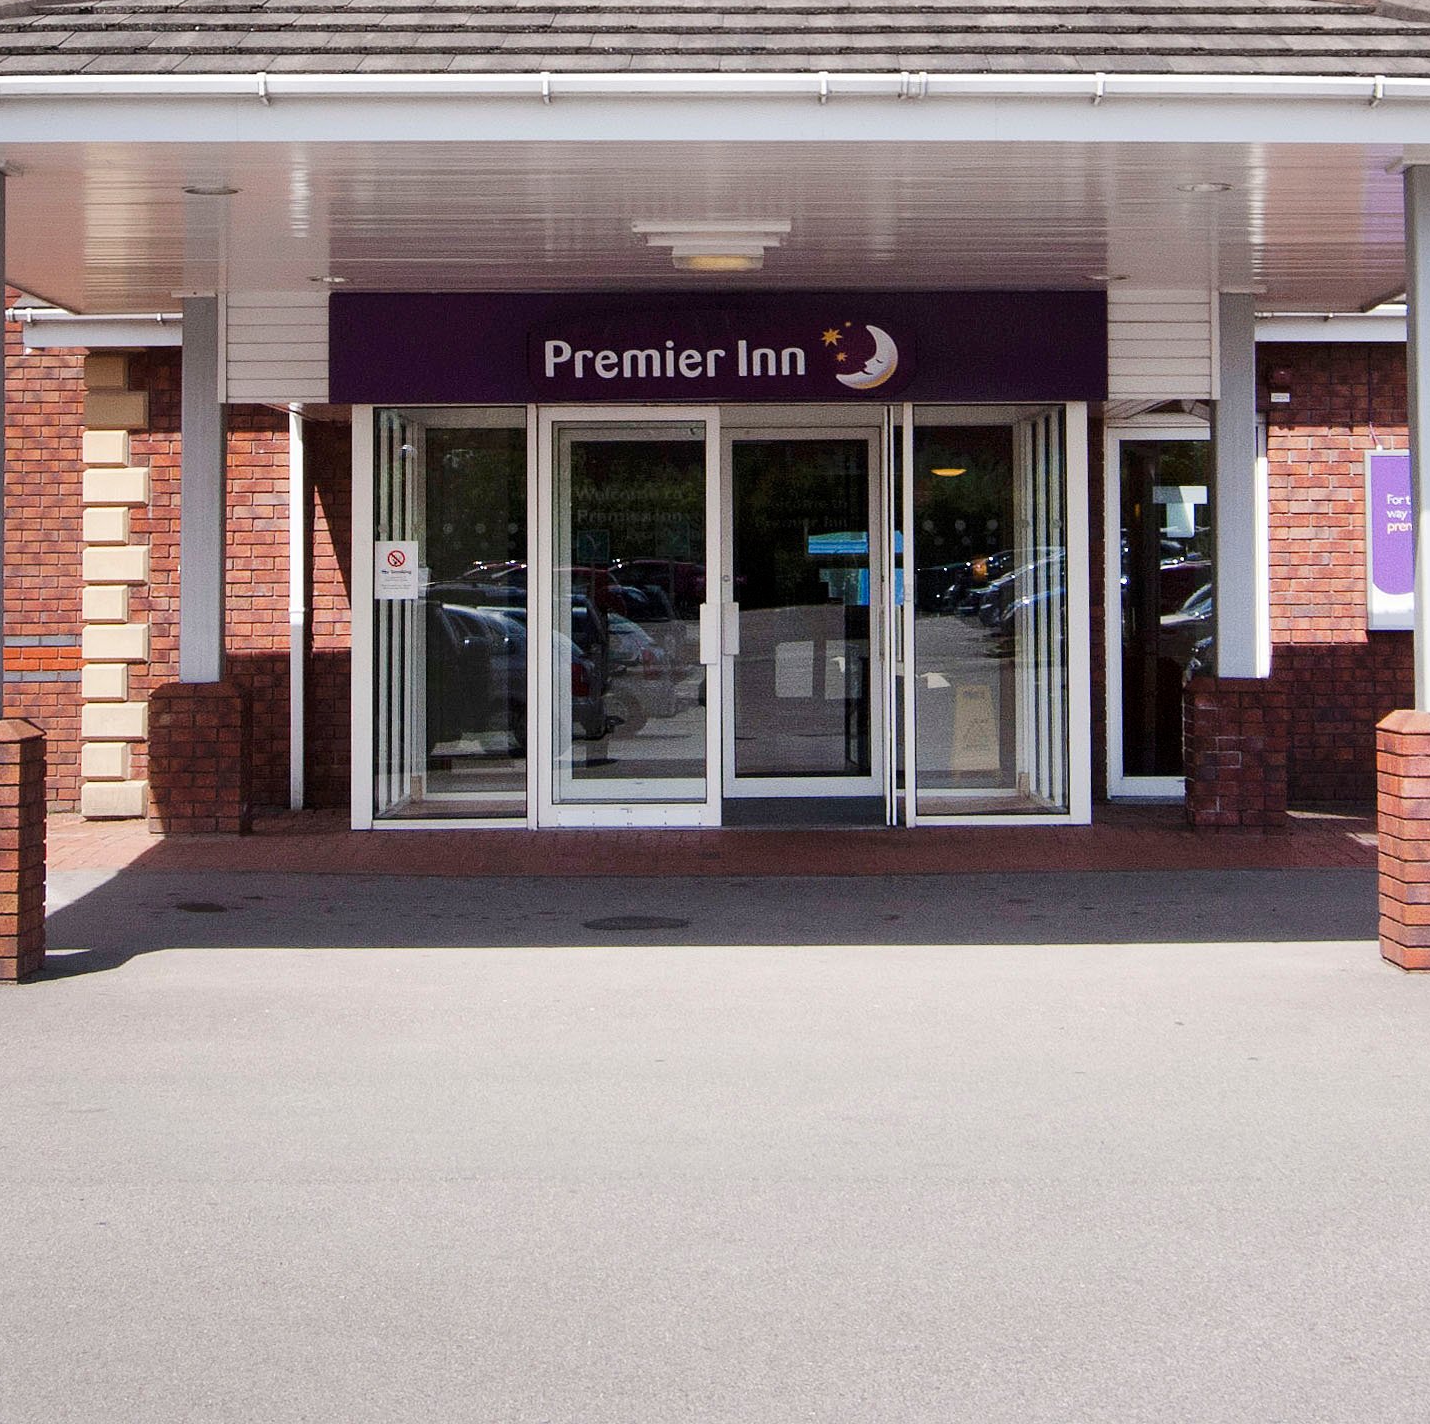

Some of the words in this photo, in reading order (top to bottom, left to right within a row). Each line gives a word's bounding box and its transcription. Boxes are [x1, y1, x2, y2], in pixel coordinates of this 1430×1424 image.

[543, 340, 726, 379] Premier
[737, 339, 807, 376] Inn
[1386, 494, 1404, 505] For
[1386, 511, 1407, 521] way
